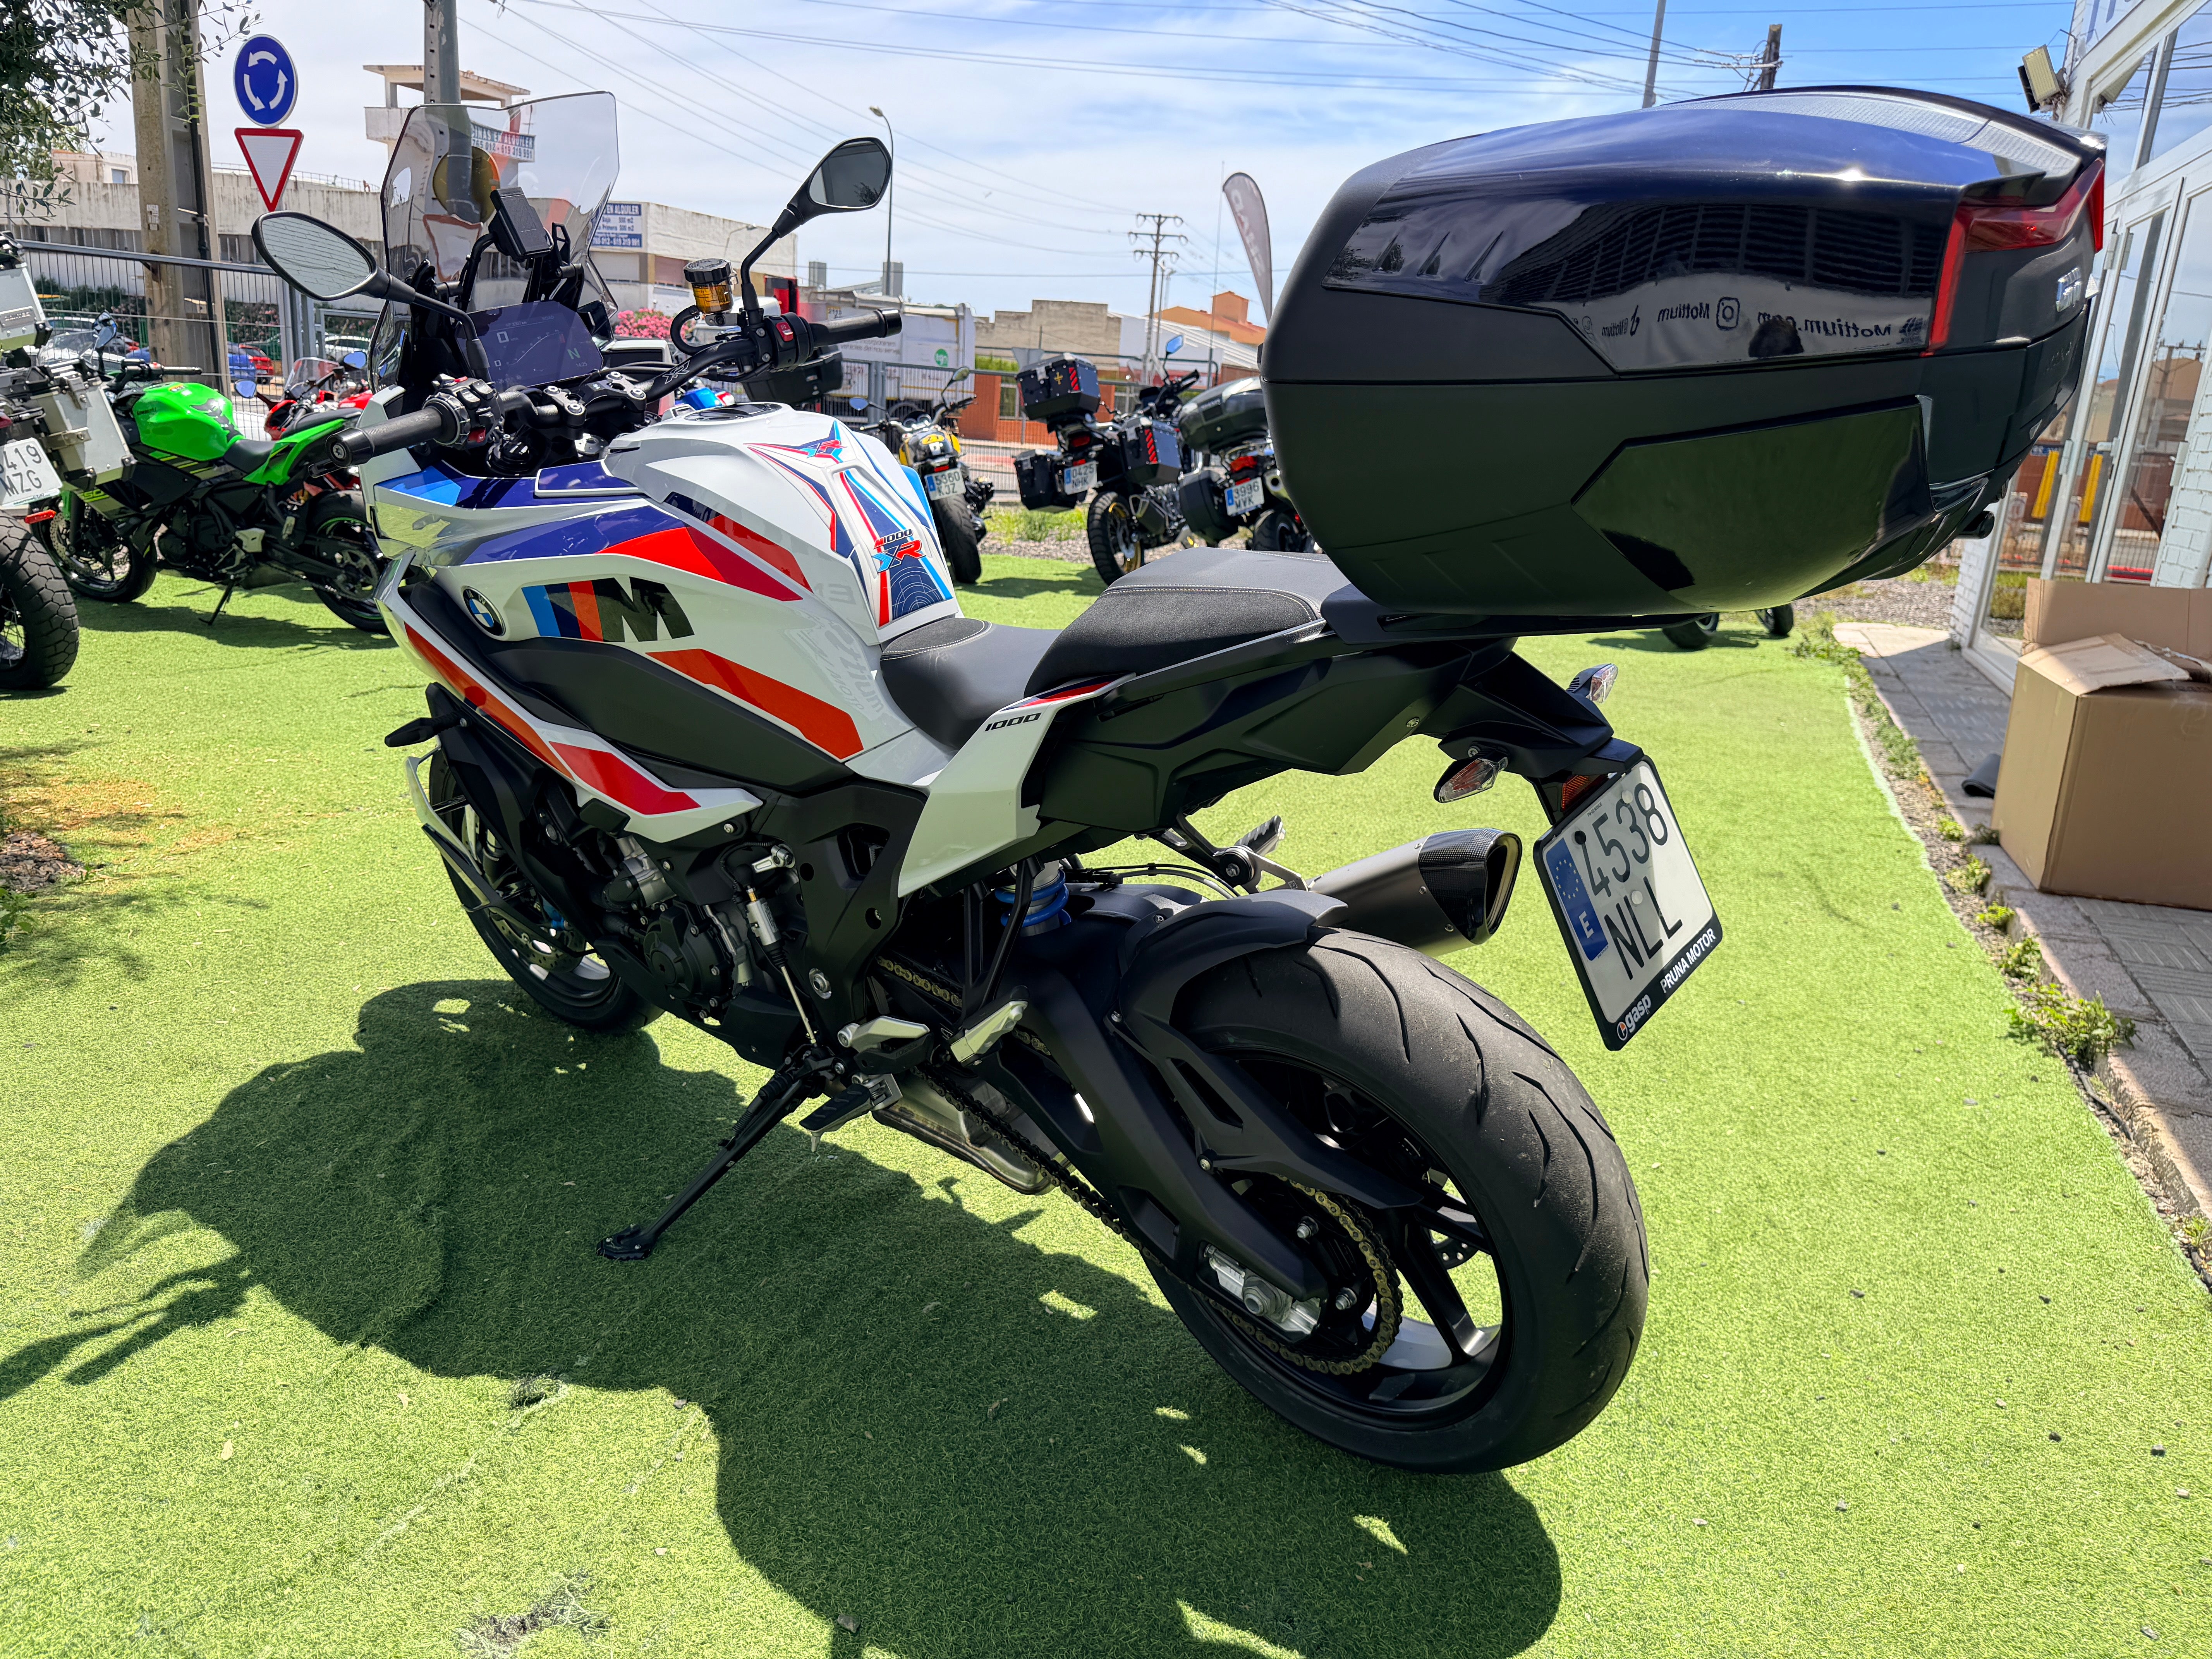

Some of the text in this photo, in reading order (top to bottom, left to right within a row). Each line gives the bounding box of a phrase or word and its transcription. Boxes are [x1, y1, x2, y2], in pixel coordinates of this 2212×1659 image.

[504, 133, 533, 148] ALQUILER
[567, 348, 581, 359] N
[0, 445, 41, 474] 419
[873, 529, 914, 550] M1000
[871, 539, 926, 573] XR
[985, 712, 1042, 732] 1000
[1580, 783, 1668, 897] 4538
[1578, 911, 1595, 939] E
[1604, 876, 1683, 980] NLL
[1660, 957, 1690, 993] PRUNA
[1688, 928, 1716, 966] MOTOR
